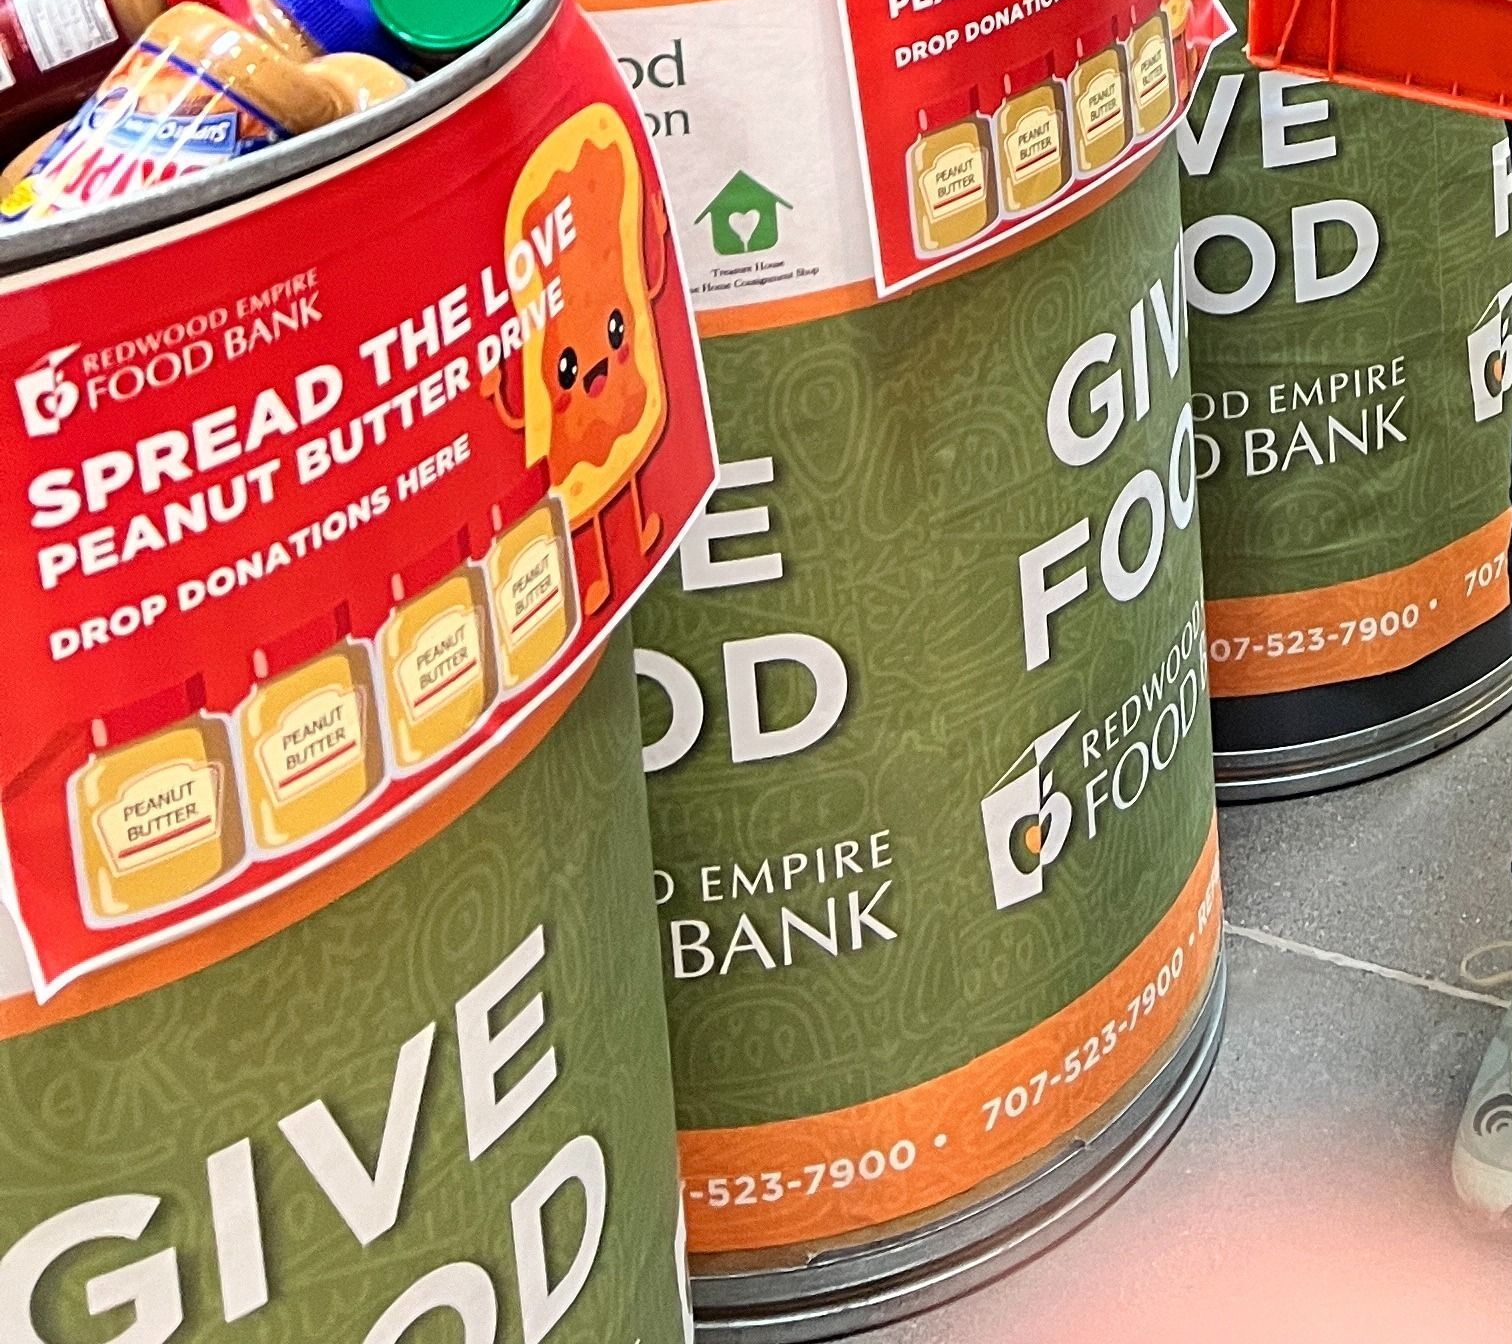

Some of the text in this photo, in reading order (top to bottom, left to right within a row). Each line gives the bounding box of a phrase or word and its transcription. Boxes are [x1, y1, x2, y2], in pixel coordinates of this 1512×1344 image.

[895, 29, 960, 69] DROP
[1140, 48, 1162, 73] PEANUT
[1088, 83, 1116, 107] PEANUT
[1090, 99, 1118, 122] BUTTER
[1017, 121, 1050, 146] PEANUT
[1019, 136, 1053, 161] BUTTER
[935, 158, 974, 184] PEANUT
[937, 174, 976, 197] BUTTER
[81, 266, 319, 377] REDWOOD EMPIRE
[1048, 224, 1189, 467] GIV
[28, 194, 578, 529] SPREAD THE LOVE
[87, 290, 323, 412] FOOD BANK
[1269, 355, 1407, 415] EMPIRE
[38, 275, 565, 590] PEANUT BUTTER DRIVE
[1245, 396, 1408, 477] BANK
[50, 433, 471, 661] DROP DONATIONS HERE
[1019, 402, 1196, 670] FOO
[511, 553, 549, 599] PEANUT
[514, 577, 559, 613] BUTTER
[415, 624, 467, 671] PEANUT
[1209, 604, 1420, 662] 07-523-7900
[418, 645, 469, 688] BUTTER
[1082, 600, 1200, 768] REDWOOD
[281, 703, 344, 749] PEANUT
[285, 725, 347, 771] BUTTER
[1086, 668, 1198, 840] FOOD
[122, 780, 195, 823] PEANUT
[126, 801, 199, 844] BUTTER
[700, 829, 893, 902] EMPIRE
[670, 879, 898, 979] BANK
[681, 946, 1184, 1209] -523-7900 707-523-7900
[0, 923, 558, 1344] GIVE
